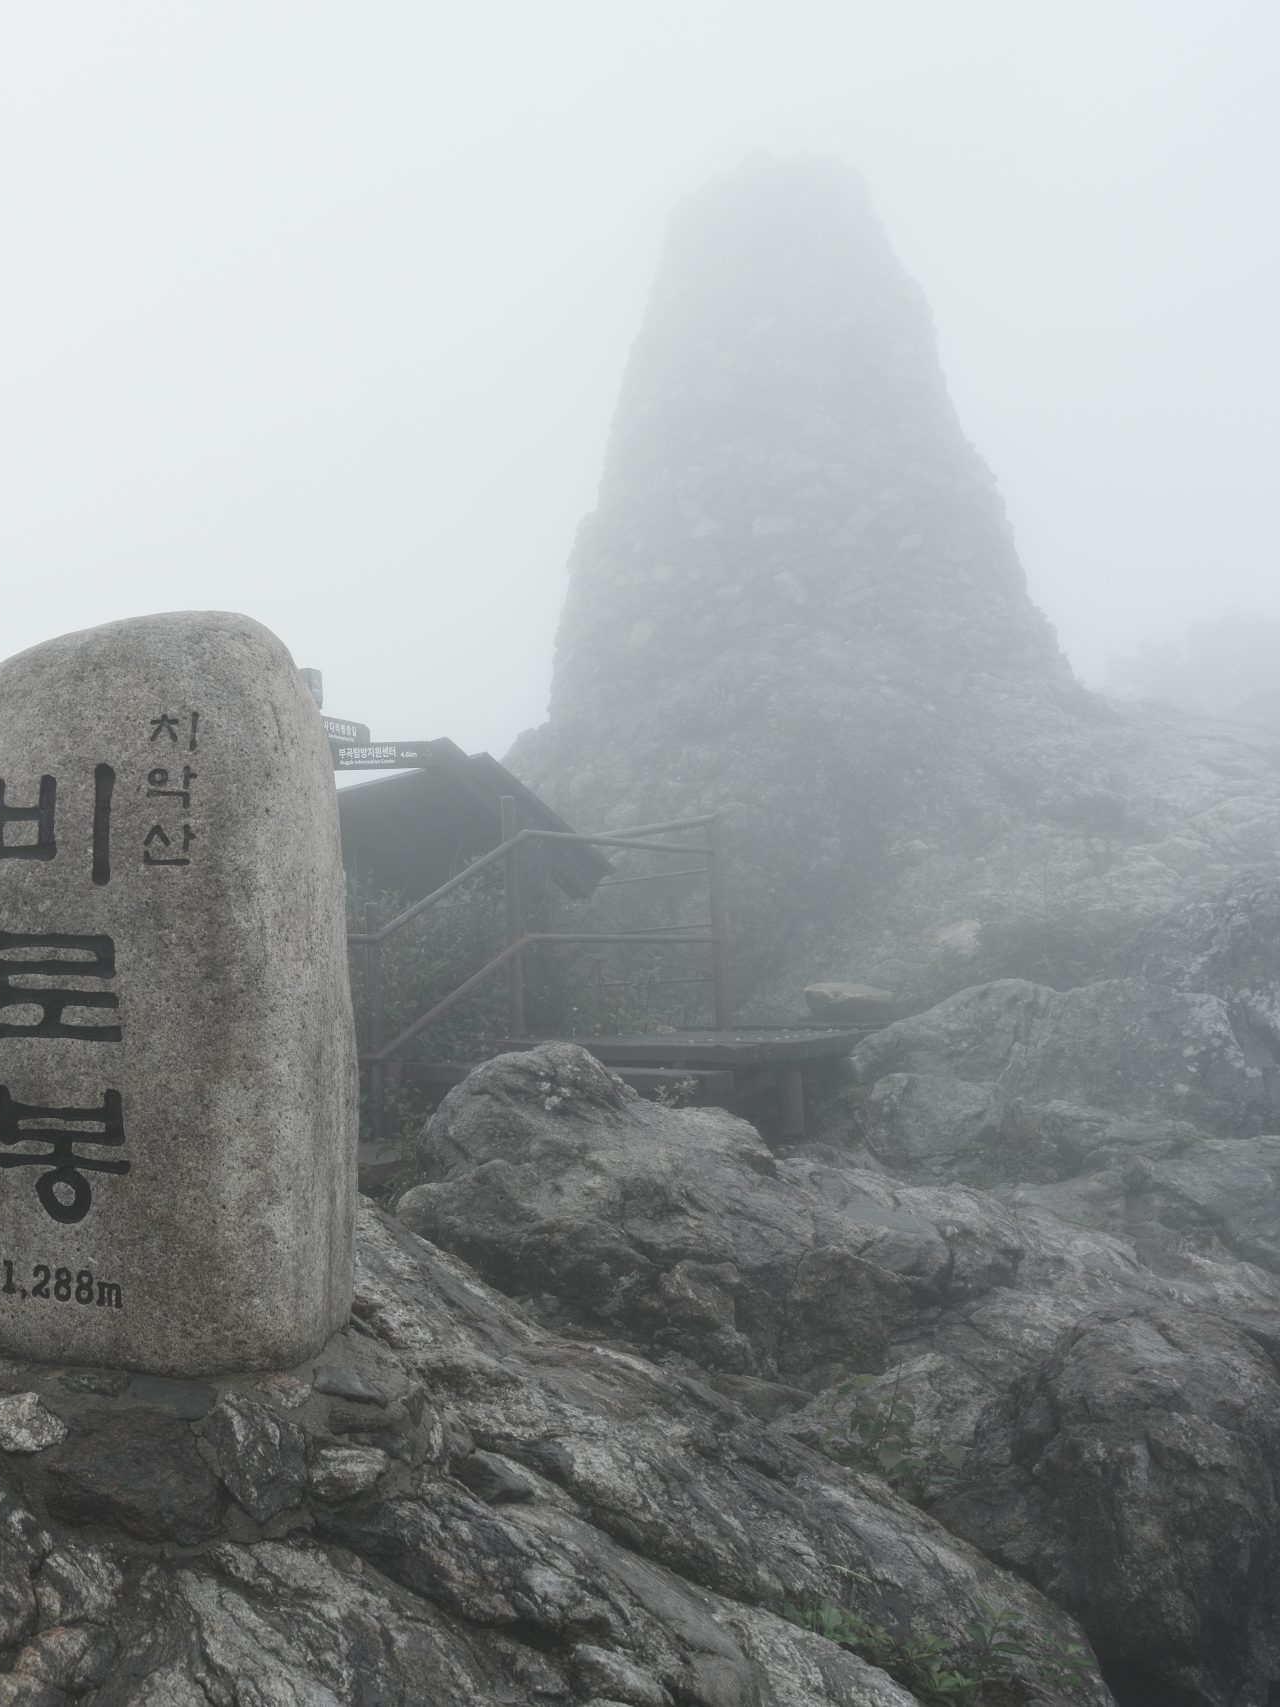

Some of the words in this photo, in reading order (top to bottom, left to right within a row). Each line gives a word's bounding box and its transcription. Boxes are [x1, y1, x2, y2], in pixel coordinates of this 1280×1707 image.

[338, 745, 397, 759] 부곡탐방지원센터
[143, 710, 201, 867] 치악산
[1, 1257, 124, 1310] 1,288m
